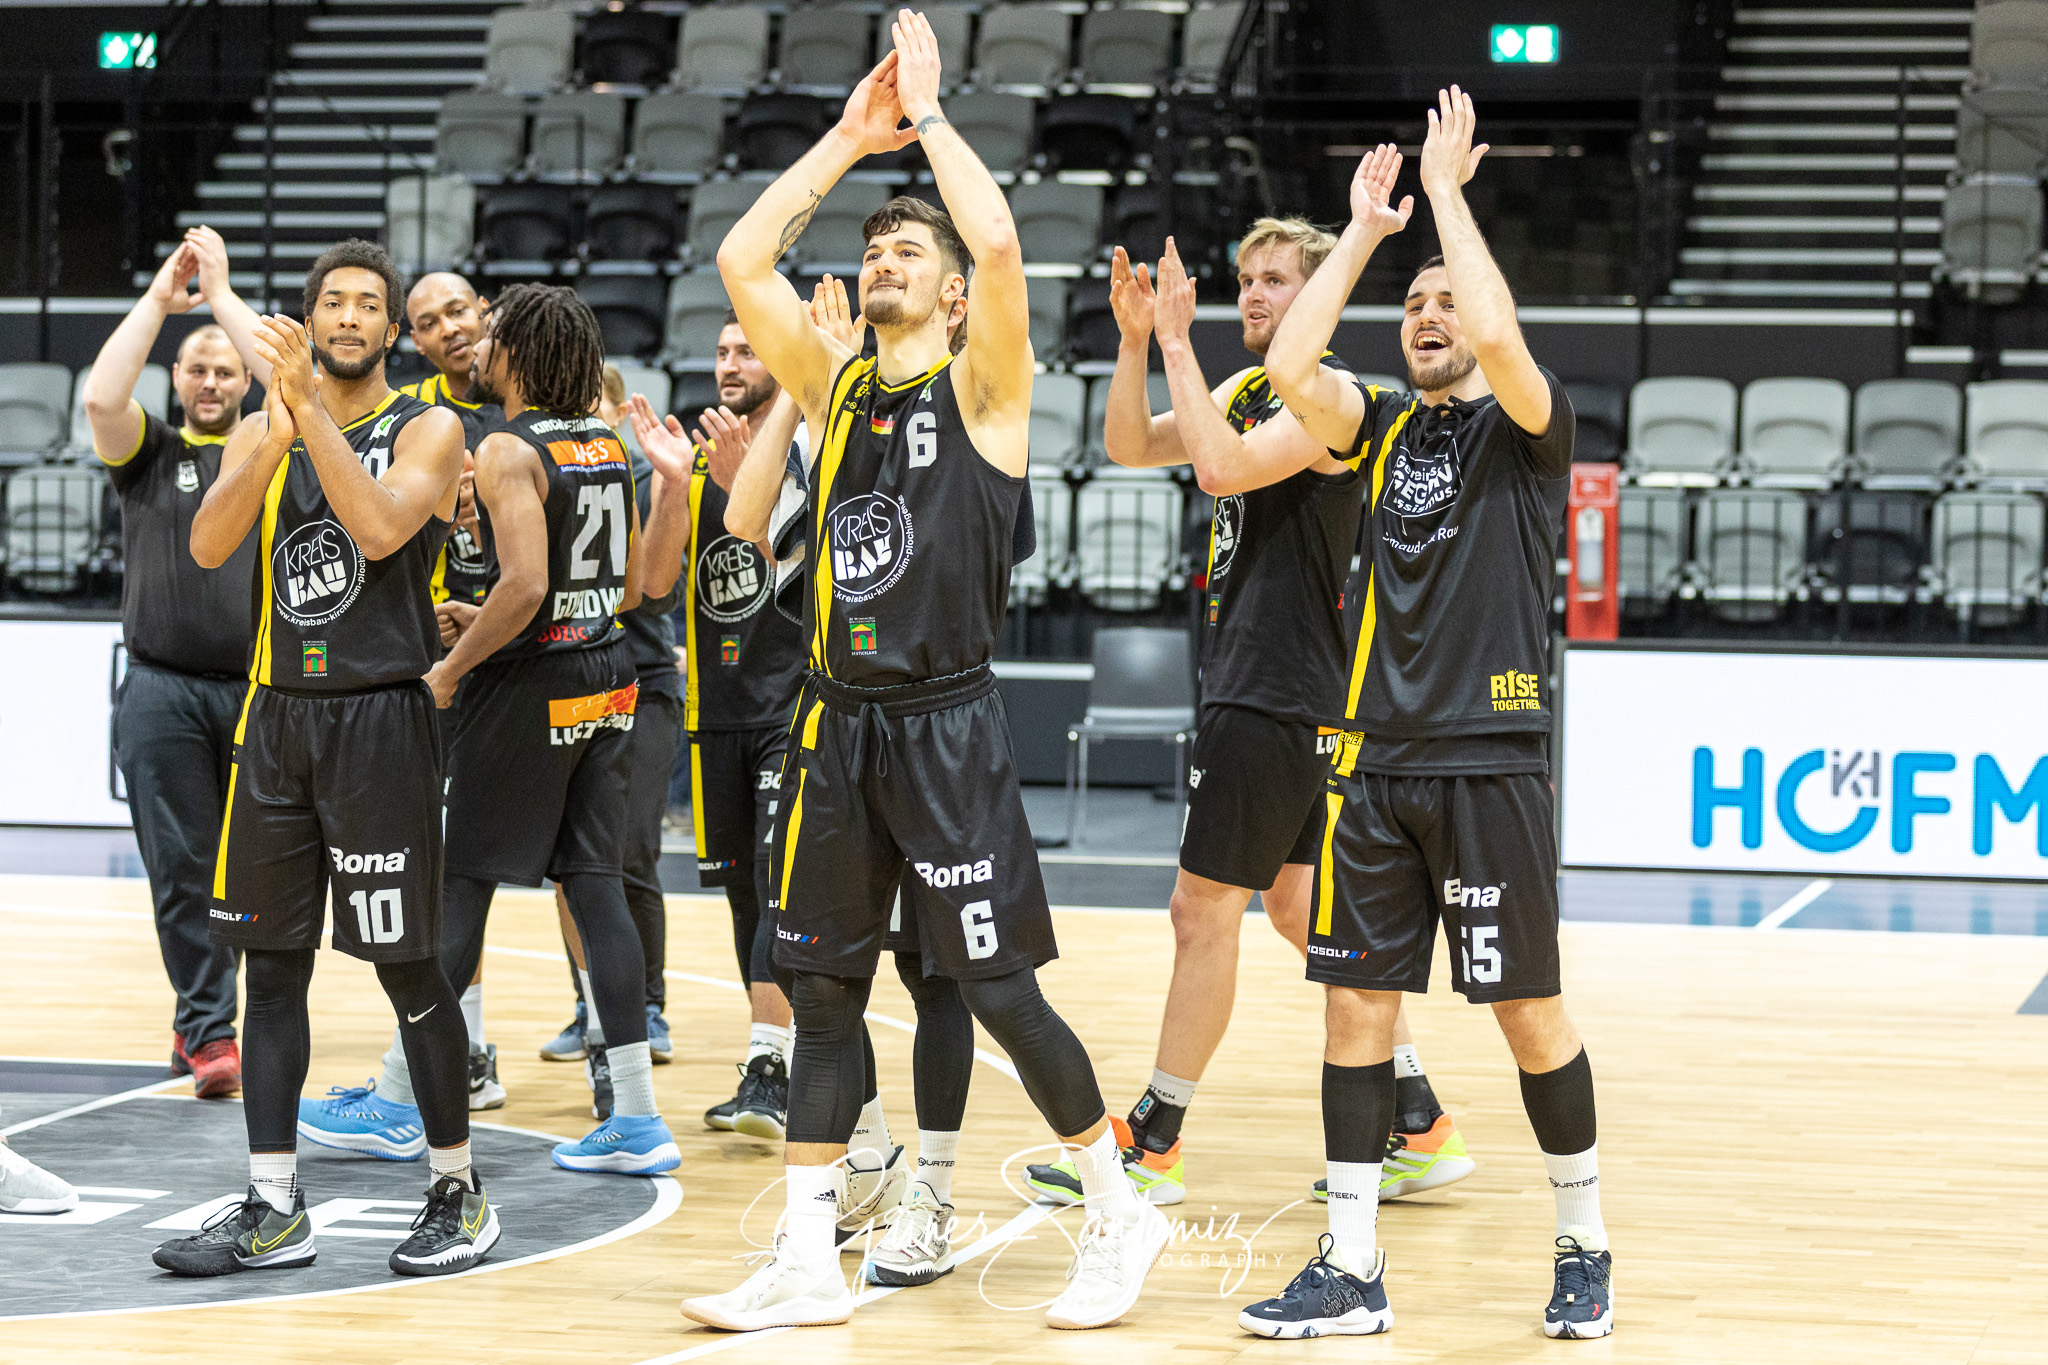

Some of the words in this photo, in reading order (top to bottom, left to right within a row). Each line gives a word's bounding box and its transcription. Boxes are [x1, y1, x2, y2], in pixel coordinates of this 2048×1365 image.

[906, 411, 937, 470] 6
[570, 482, 627, 580] 21
[834, 501, 891, 547] KREIS
[284, 528, 341, 576] KREIS
[705, 541, 755, 580] KREIS
[834, 533, 893, 581] BAU
[287, 560, 347, 608] BAU
[708, 567, 760, 608] BAU
[1490, 669, 1539, 699] RISE
[1491, 698, 1541, 712] TOGETHER
[348, 888, 405, 944] 10
[1444, 878, 1502, 908] Bna
[960, 899, 999, 960] 6
